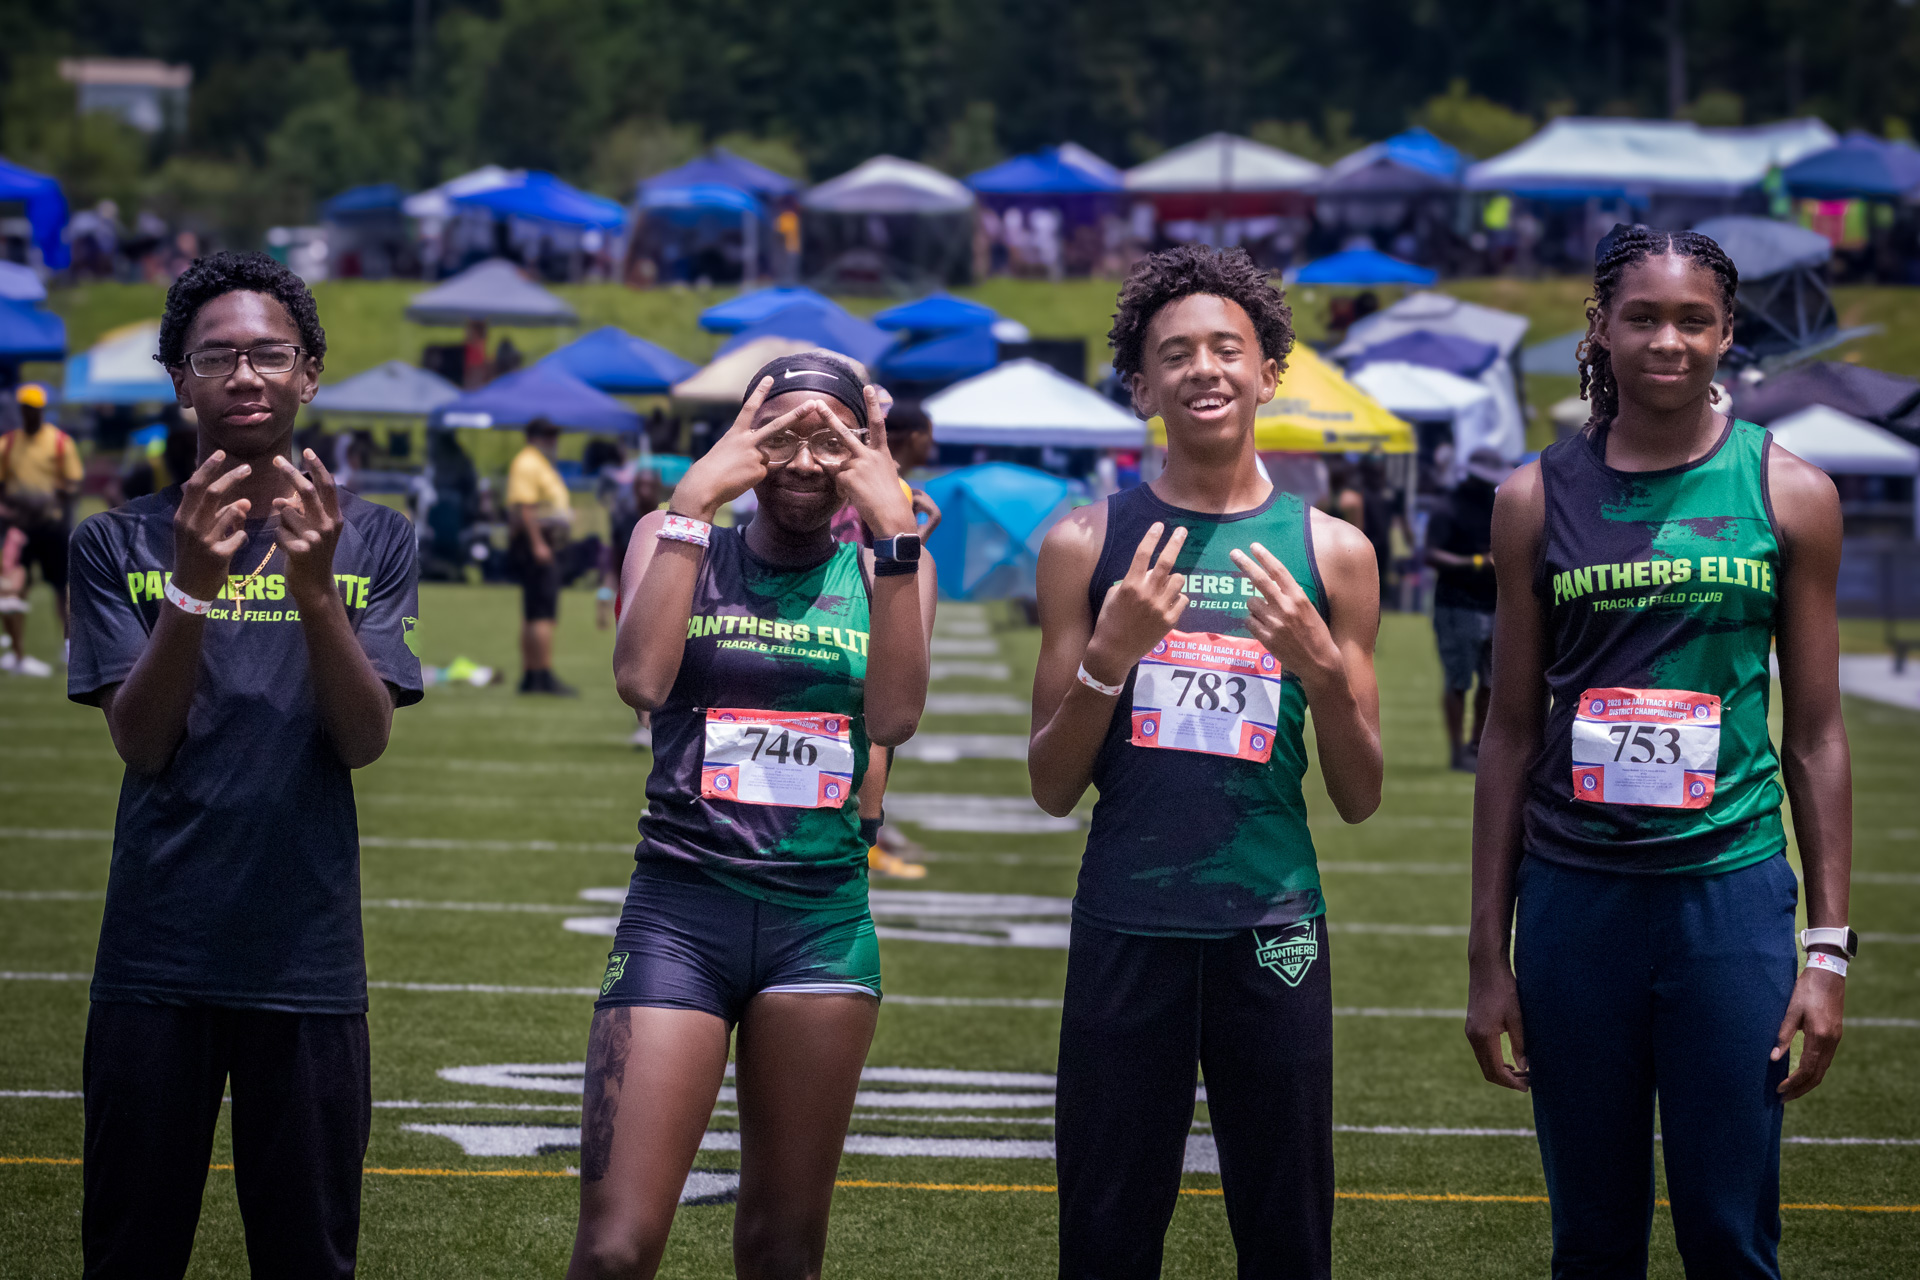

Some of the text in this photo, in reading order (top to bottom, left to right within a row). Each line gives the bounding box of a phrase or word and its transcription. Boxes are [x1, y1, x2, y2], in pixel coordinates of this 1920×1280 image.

[127, 571, 286, 604] PAERS
[1553, 556, 1771, 606] PANTHERS ELITE
[1190, 600, 1198, 608] &
[1200, 600, 1230, 609] FIELD
[1592, 592, 1723, 612] TRACK & FIELD CLUB
[243, 610, 283, 622] FIELD
[285, 610, 302, 622] CL
[687, 615, 870, 657] ANTHERS ELIT
[716, 640, 840, 660] TRACK & FIELD CLUB
[1171, 650, 1256, 669] DISTRICT CHAMPIONSHIPS
[1187, 641, 1197, 650] NC
[1198, 643, 1212, 653] AAU
[1213, 645, 1235, 655] TRACK
[1235, 648, 1241, 656] &
[1242, 649, 1260, 660] FIELD
[1170, 669, 1247, 714] 783
[1608, 707, 1687, 720] DISTRICT CHAMPIONSHIPS
[1622, 698, 1631, 706] NC
[1631, 698, 1645, 706] AAU
[1645, 698, 1667, 707] TRACK
[1667, 700, 1673, 708] &
[1674, 701, 1692, 711] FIELD
[744, 726, 818, 767] 746
[1608, 725, 1682, 764] 753
[1262, 945, 1315, 961] PANTHERS
[1282, 956, 1302, 965] ELITE
